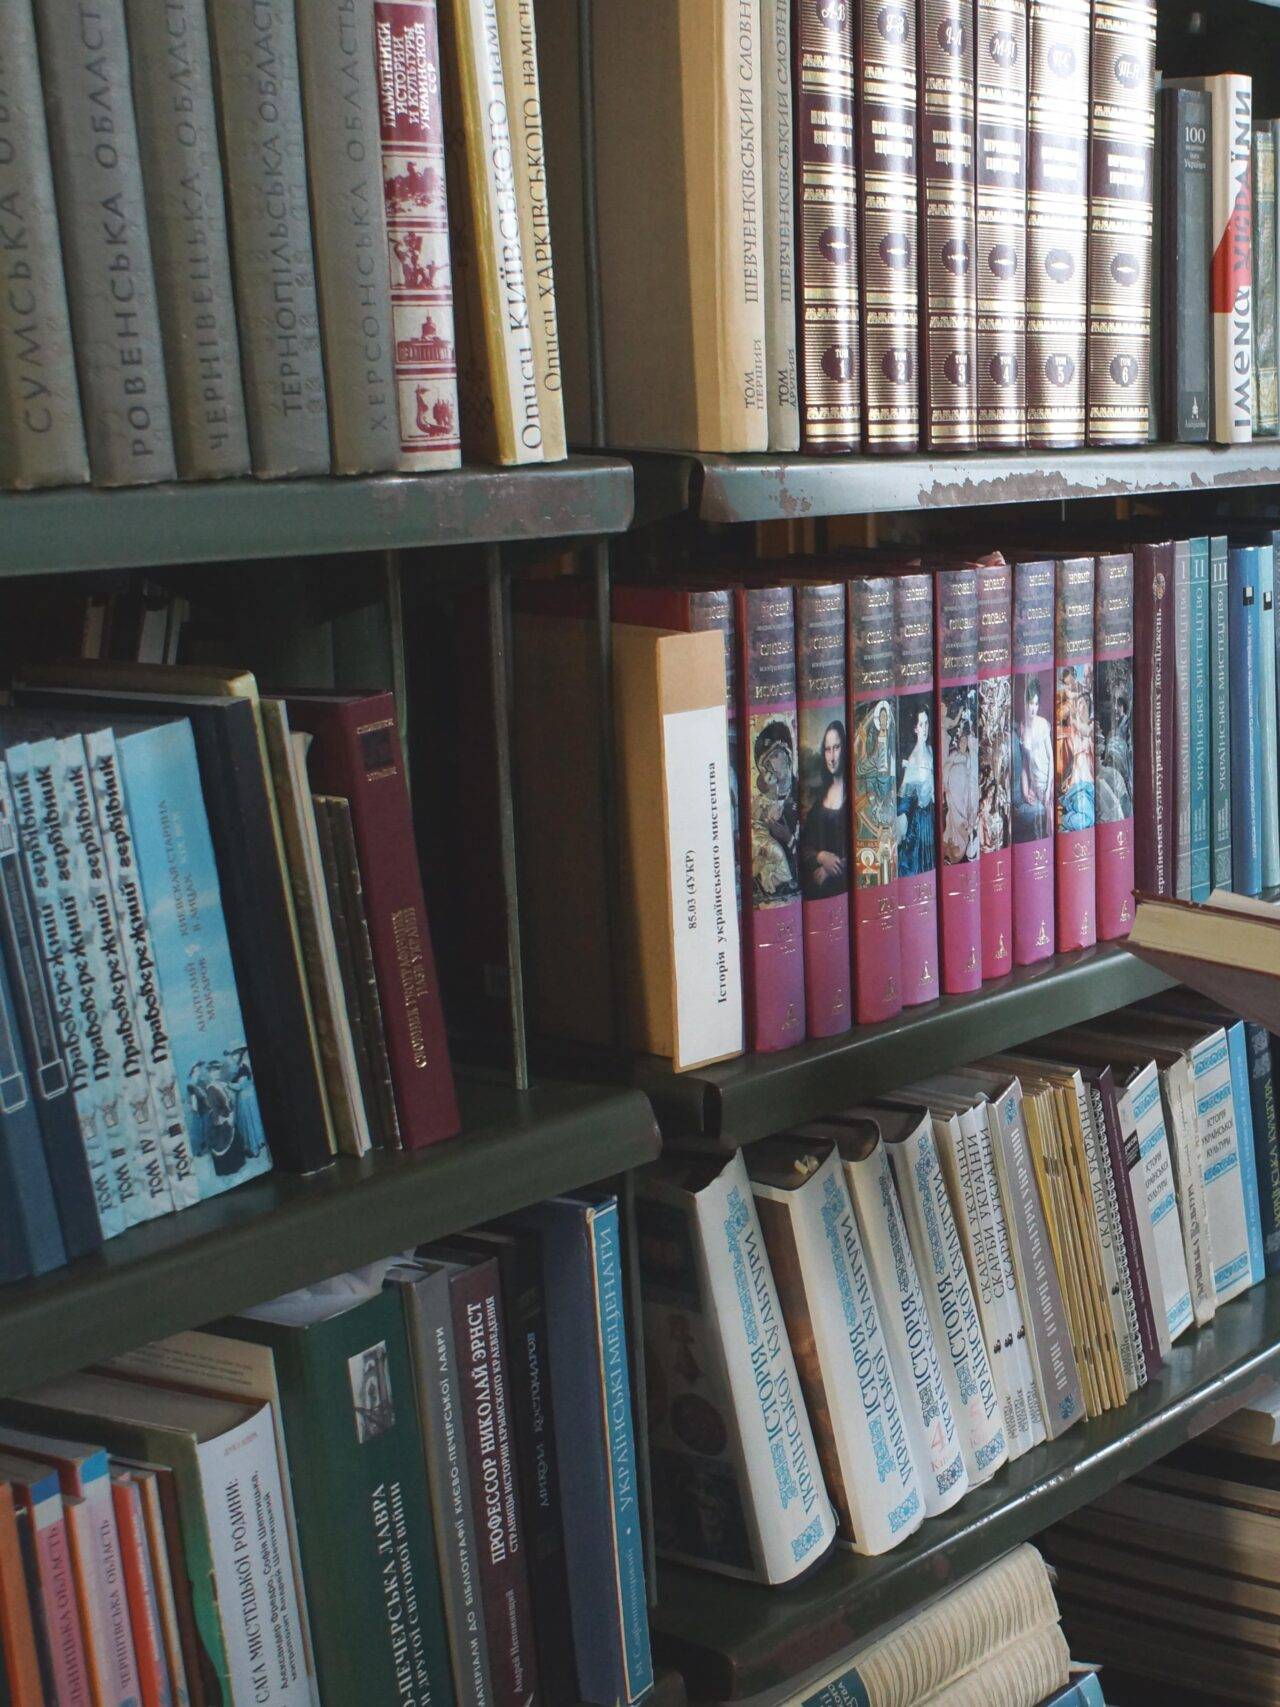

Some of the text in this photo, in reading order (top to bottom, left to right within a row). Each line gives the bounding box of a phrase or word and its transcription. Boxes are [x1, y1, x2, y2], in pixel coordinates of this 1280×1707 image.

[1184, 126, 1206, 144] 100
[738, 87, 759, 304] ШЕВЧЕНКІВСЬКИЙ
[776, 91, 792, 303] ШЕВЧЕНКІВСЬКИЙ
[262, 135, 303, 417] ТЕРНОПІЛЬСЬКА
[488, 100, 543, 449] Описи КИЇВСЬКОГО
[523, 98, 561, 392] Описи ХАРКІВСЬКОГО
[0, 192, 51, 433] СУМСЬКА
[100, 193, 153, 456] РОВЕНСЬКА
[180, 173, 228, 450] ЧЕРНІВЕЦЬКА
[351, 181, 389, 431] ХЕРСОНСЬКА
[744, 371, 756, 409] ТОМ
[754, 337, 764, 410] ПЕРШИЙ
[779, 368, 790, 407] ТОМ
[834, 348, 848, 359] ТОМ
[839, 360, 846, 379] 1
[893, 351, 907, 361] ТОМ
[897, 362, 905, 380] 2
[955, 354, 968, 364] ТОМ
[958, 365, 966, 382] 3
[1000, 355, 1012, 364] ТОМ
[1002, 365, 1010, 383] 4
[1055, 356, 1067, 366] ТОМ
[1057, 367, 1065, 383] 5
[1119, 357, 1131, 366] ТОМ
[1121, 367, 1129, 384] 6
[1194, 560, 1205, 579] II
[1213, 562, 1227, 582] III
[1179, 589, 1189, 690] МИСТЕЦТВО
[1196, 587, 1204, 689] МИСТЕЦТВО
[1217, 591, 1226, 690] МИСТЕЦТВО
[1181, 697, 1190, 794] УКРАЇНСЬКЕ
[1196, 695, 1205, 791] УКРАЇНСЬКЕ
[1217, 695, 1226, 791] УКРАЇНСЬКЕ
[687, 898, 697, 929] 85.03
[707, 762, 729, 1003] Історія українського мистецтва
[1200, 1119, 1234, 1147] УКРАЇНСЬКОЇ
[1205, 1136, 1231, 1158] КУЛЬТУРИ
[1206, 1108, 1227, 1128] ІСТОРІЯ
[1264, 1078, 1277, 1144] КУЛЬТУРА
[94, 1174, 118, 1214] ТОМ
[116, 1163, 134, 1203] ТОМ
[145, 1158, 164, 1198] ТОМ
[172, 1142, 190, 1181] ТОМ
[1078, 1095, 1112, 1249] СКАРБИ УКРАЇНИ
[1145, 1151, 1162, 1172] ІСТОРІЯ
[933, 1167, 966, 1279] КУЛЬТУРИ
[956, 1139, 992, 1305] СКАРБИ УКРАЇНИ
[967, 1133, 1005, 1300] СКАРБИ УКРАЇНИ
[979, 1126, 1018, 1291] СКАРБИ УКРАЇНИ
[840, 1213, 875, 1340] КУЛЬТУРИ
[937, 1274, 969, 1368] ІСТОРІЯ
[435, 1326, 449, 1372] ЛАВРИ
[600, 1228, 635, 1513] УКРАЇНСЬКІ МЕЦЕНАТИ
[743, 1231, 814, 1516] УКРАЇНСЬКОЇ КУЛЬТУРИ
[848, 1321, 881, 1418] ІСТОРІЯ
[900, 1291, 931, 1389] ІСТОРІЯ
[955, 1280, 999, 1420] УКРАЇНСЬКОЇ
[467, 1302, 506, 1565] ПРОФЕССОР НИКОЛАЙ ЭРНСТ
[485, 1296, 519, 1553] СТРАНИЦЫ ИСТОРИИ КРЫМСКОГО КРАЕВЕДЕНИЯ
[749, 1343, 783, 1442] ІСТОРІЯ
[870, 1346, 911, 1487] УКРАЇНСЬКОЇ
[439, 1378, 464, 1514] КИЄВО-ПЕЧЕРСЬКОЇ
[225, 1478, 248, 1554] РОДИНИ:
[262, 1541, 275, 1574] Софія
[372, 1482, 394, 1554] ЛАВРА
[46, 1527, 70, 1611] ОБЛАСТЬ
[101, 1519, 131, 1689] ЧЕРНІГІВСЬКА ОБЛАСТЬ
[232, 1556, 265, 1662] МИСТЕЦЬКОЇ
[390, 1481, 430, 1688] ДРУГОЇ СВІТОВОЇ ВІЙНИ
[467, 1611, 479, 1632] ДО
[252, 1657, 270, 1704] САГА
[511, 1655, 523, 1693] Андрей
